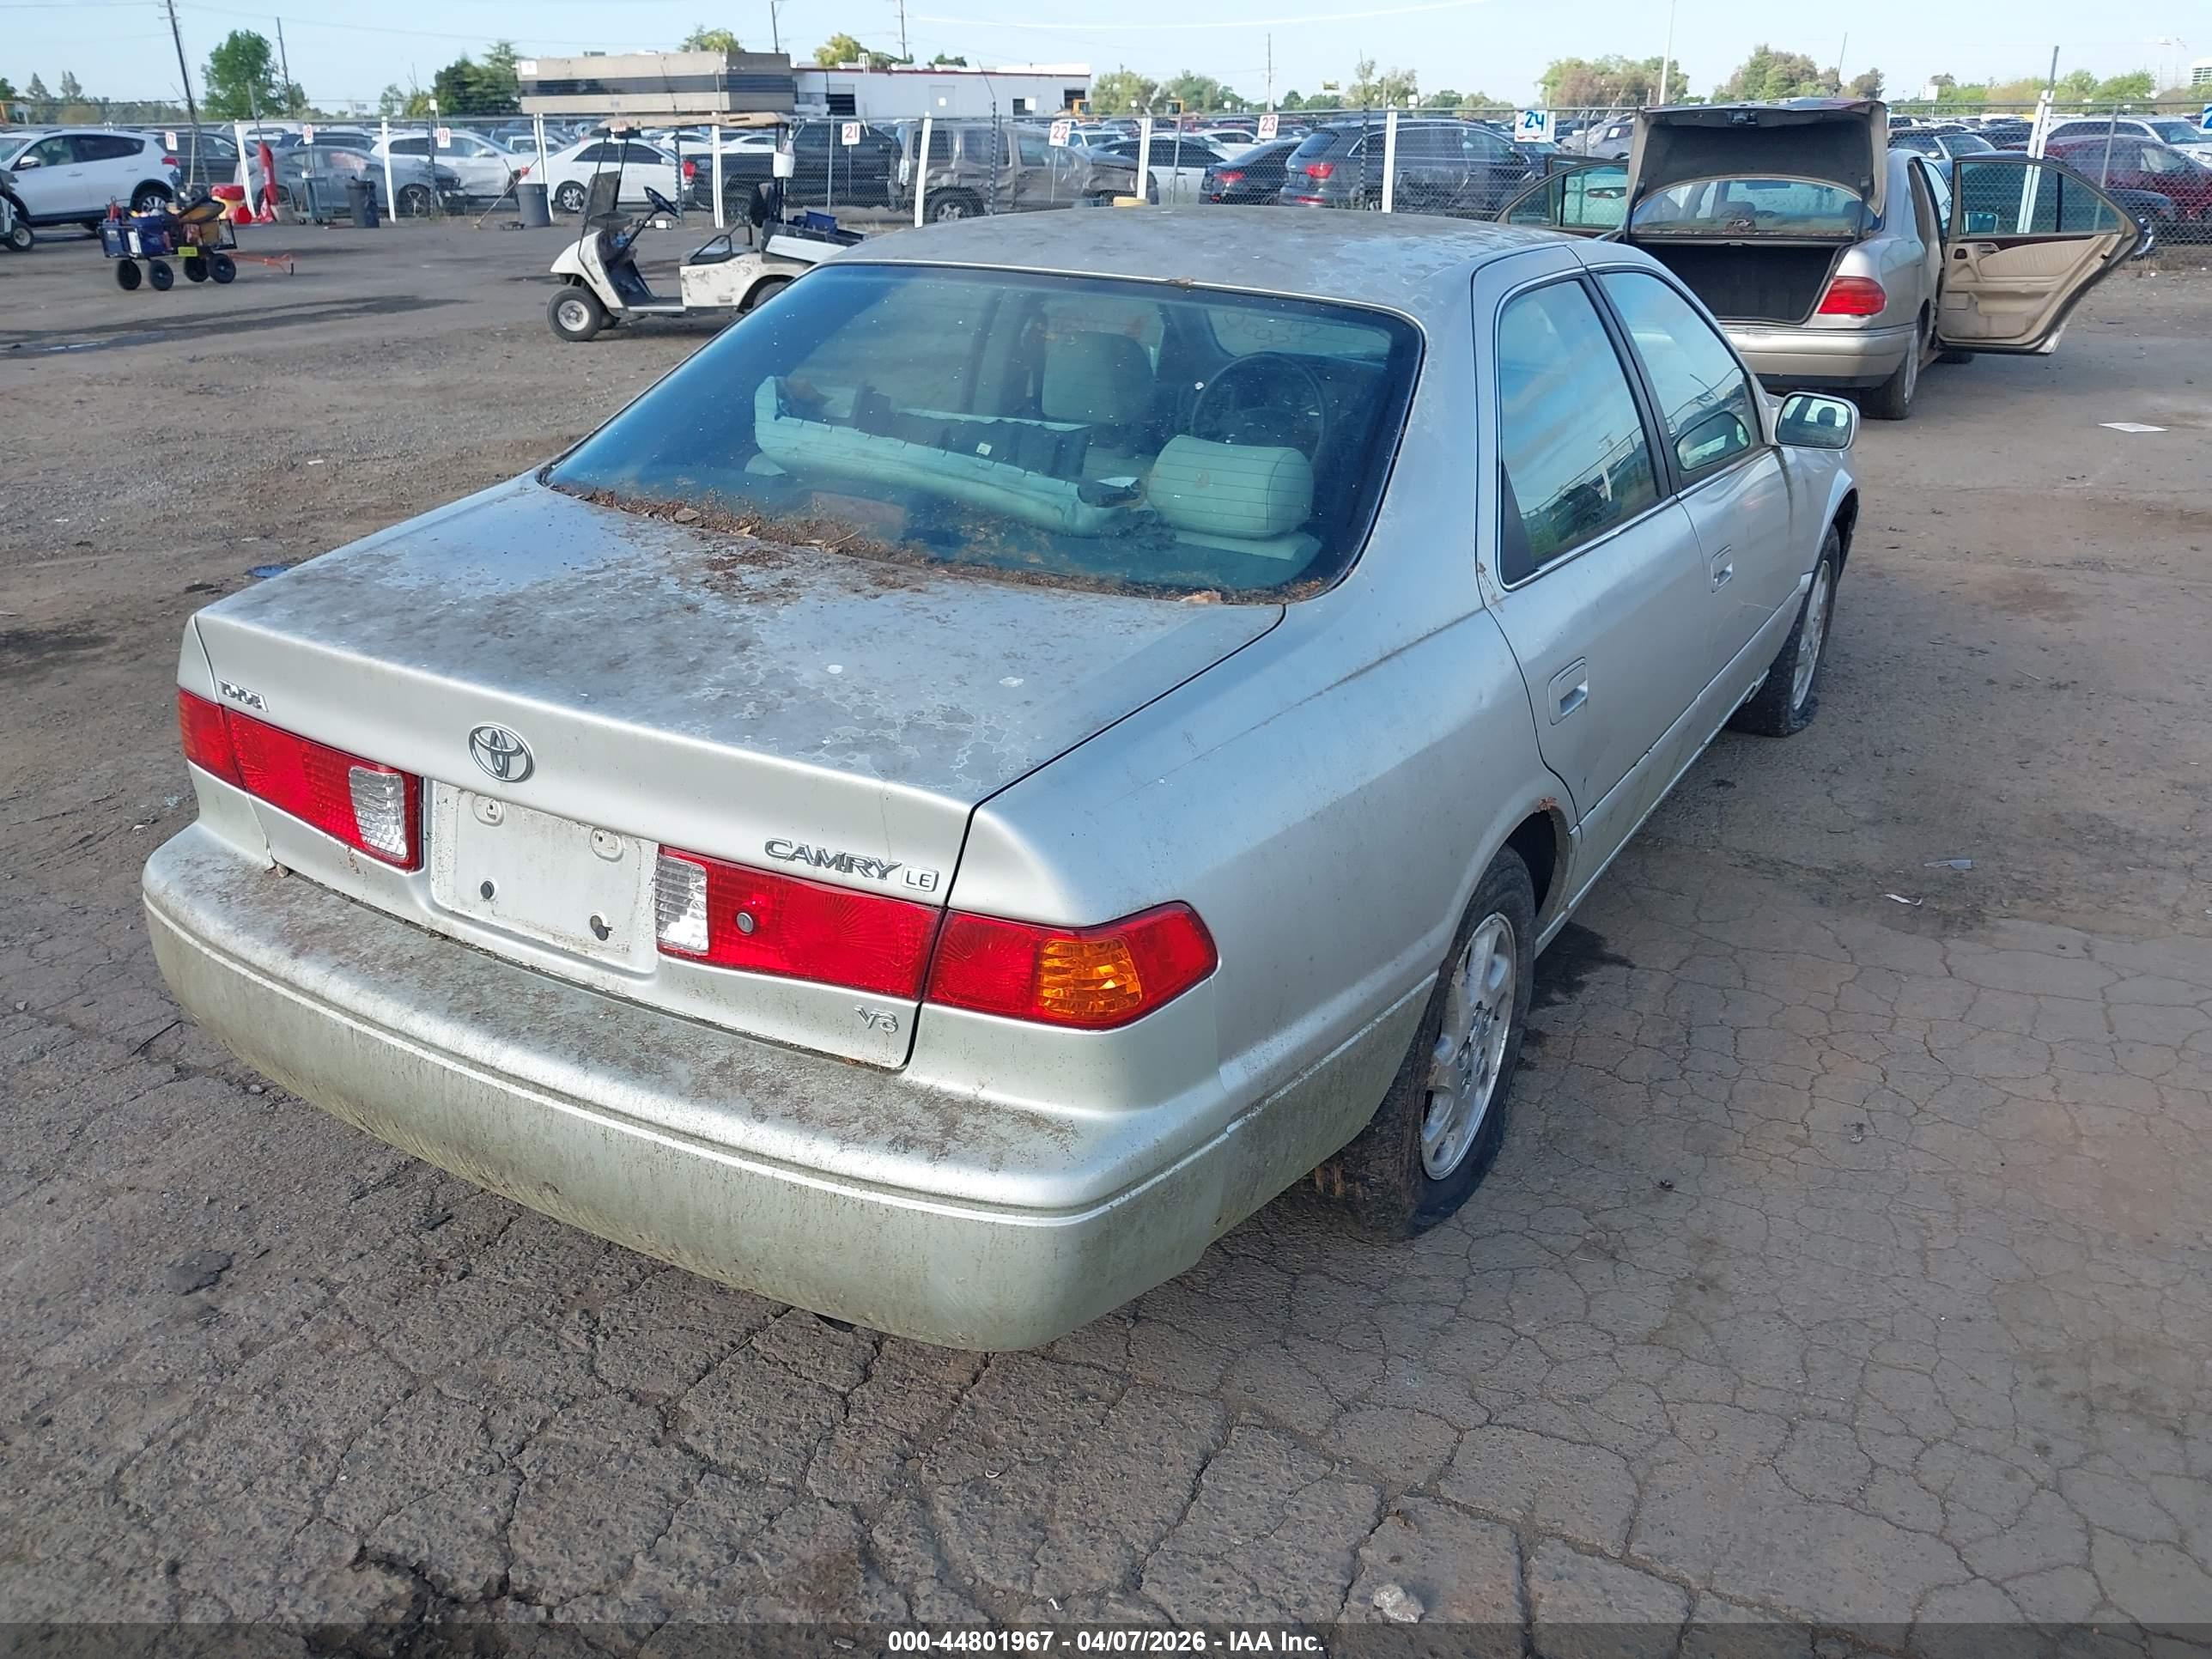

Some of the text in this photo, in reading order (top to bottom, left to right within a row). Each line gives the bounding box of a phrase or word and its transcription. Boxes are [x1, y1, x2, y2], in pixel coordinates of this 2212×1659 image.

[1261, 116, 1276, 132] 23
[1524, 111, 1545, 131] 24
[439, 129, 448, 143] 19
[845, 125, 858, 138] 21
[1052, 125, 1067, 139] 22
[167, 133, 175, 146] 17
[764, 837, 934, 890] CAMRY LE
[854, 1004, 898, 1033] V6
